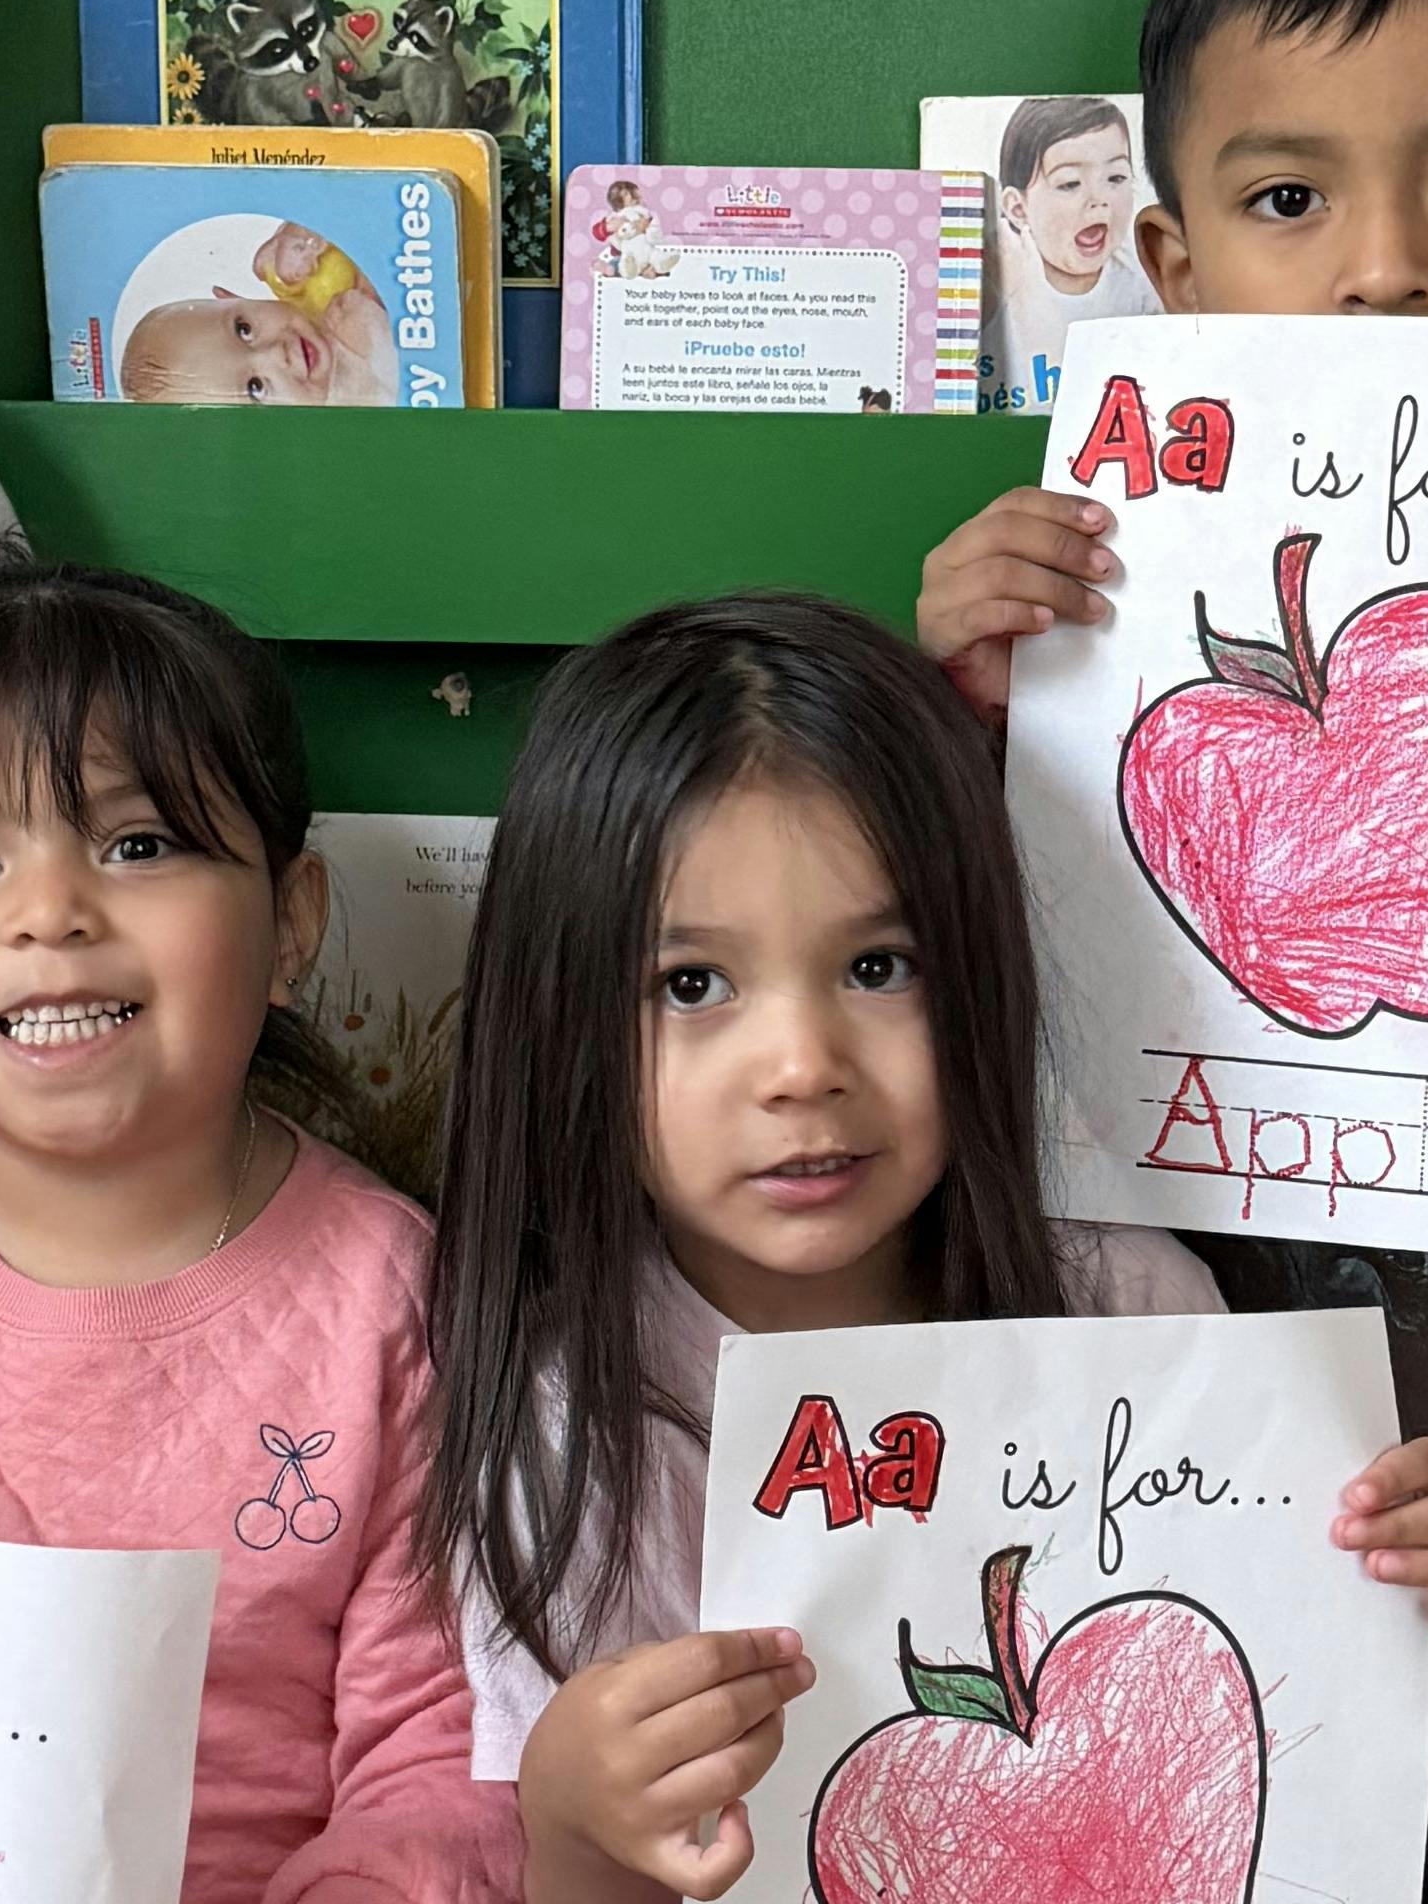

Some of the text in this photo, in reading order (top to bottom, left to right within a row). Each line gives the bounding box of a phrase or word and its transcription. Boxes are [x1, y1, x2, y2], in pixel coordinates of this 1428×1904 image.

[726, 184, 781, 204] Little
[395, 183, 436, 349] Bathes
[709, 266, 786, 283] Try This!
[684, 340, 806, 358] ¡Pruebe esto!
[1070, 375, 1235, 502] Aa
[1293, 433, 1363, 498] is
[416, 846, 456, 862] We'll
[406, 878, 456, 893] before
[752, 1394, 1293, 1576] Aa is for...
